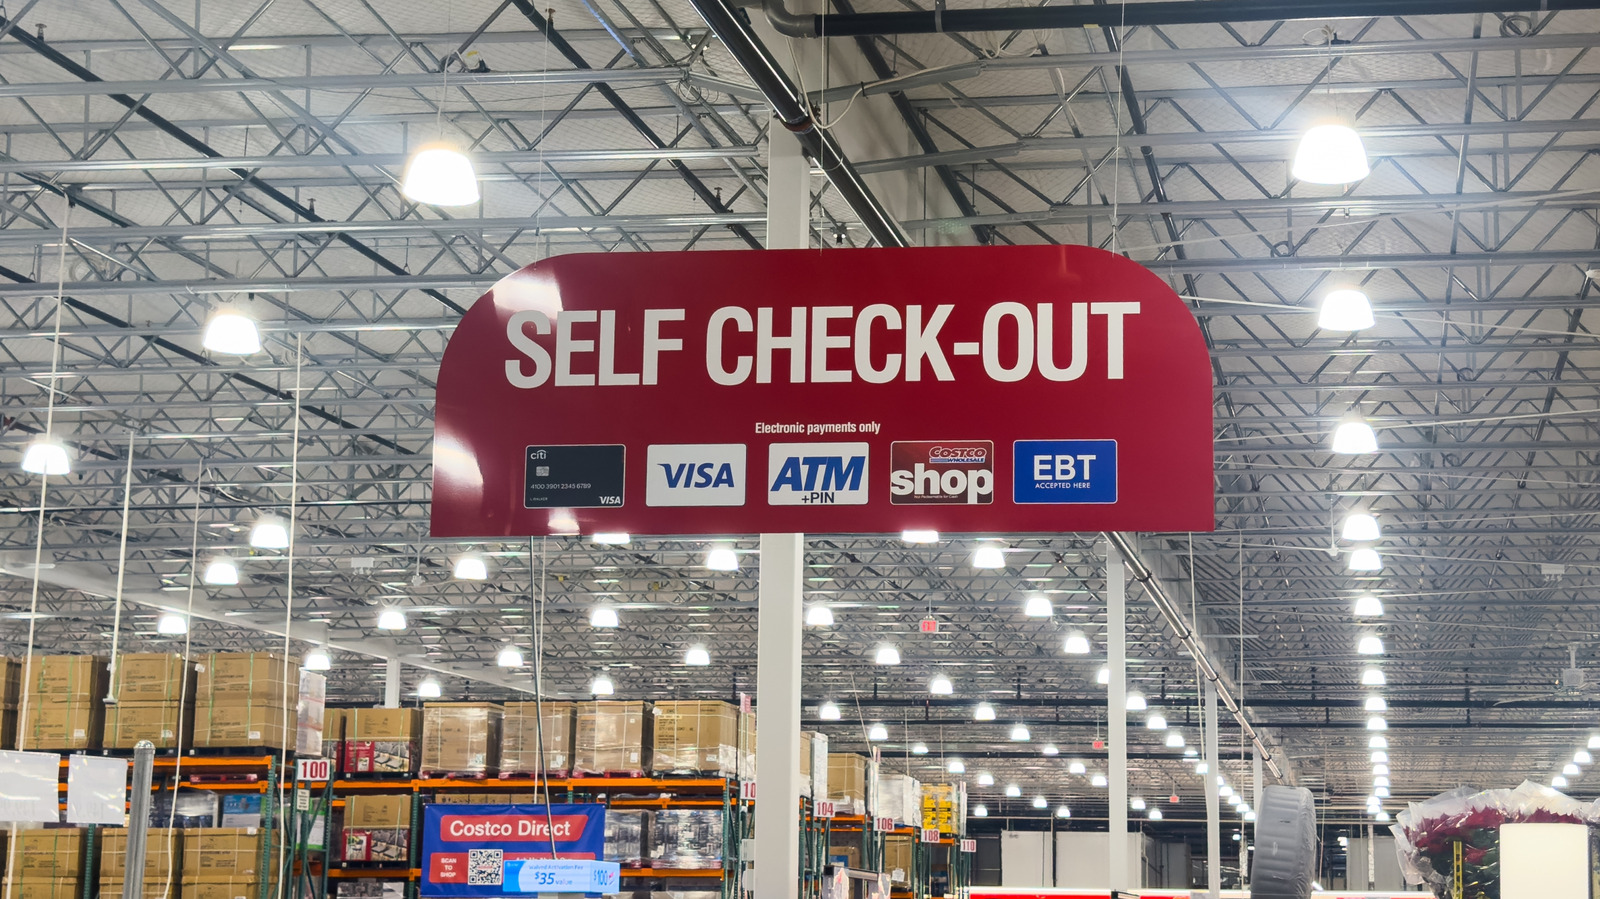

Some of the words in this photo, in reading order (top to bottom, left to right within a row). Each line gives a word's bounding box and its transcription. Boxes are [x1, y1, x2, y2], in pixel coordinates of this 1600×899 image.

[505, 308, 686, 389] SELF
[705, 301, 1141, 386] CHECK-OUT
[755, 422, 805, 434] Electronic
[807, 421, 857, 436] payments
[859, 420, 881, 435] only
[530, 449, 547, 460] citi
[657, 462, 735, 489] VISA
[770, 455, 866, 492] ATM
[1033, 454, 1097, 481] EBT
[891, 462, 993, 505] shop
[599, 495, 621, 505] VISA
[801, 492, 835, 504] +PIN
[302, 761, 328, 779] 100
[743, 782, 757, 799] 10
[816, 802, 834, 816] 104
[450, 820, 513, 837] Costco
[517, 819, 571, 836] Direct
[876, 818, 893, 831] 106
[923, 830, 940, 842] 108
[961, 840, 975, 851] 110
[535, 871, 556, 885] $35
